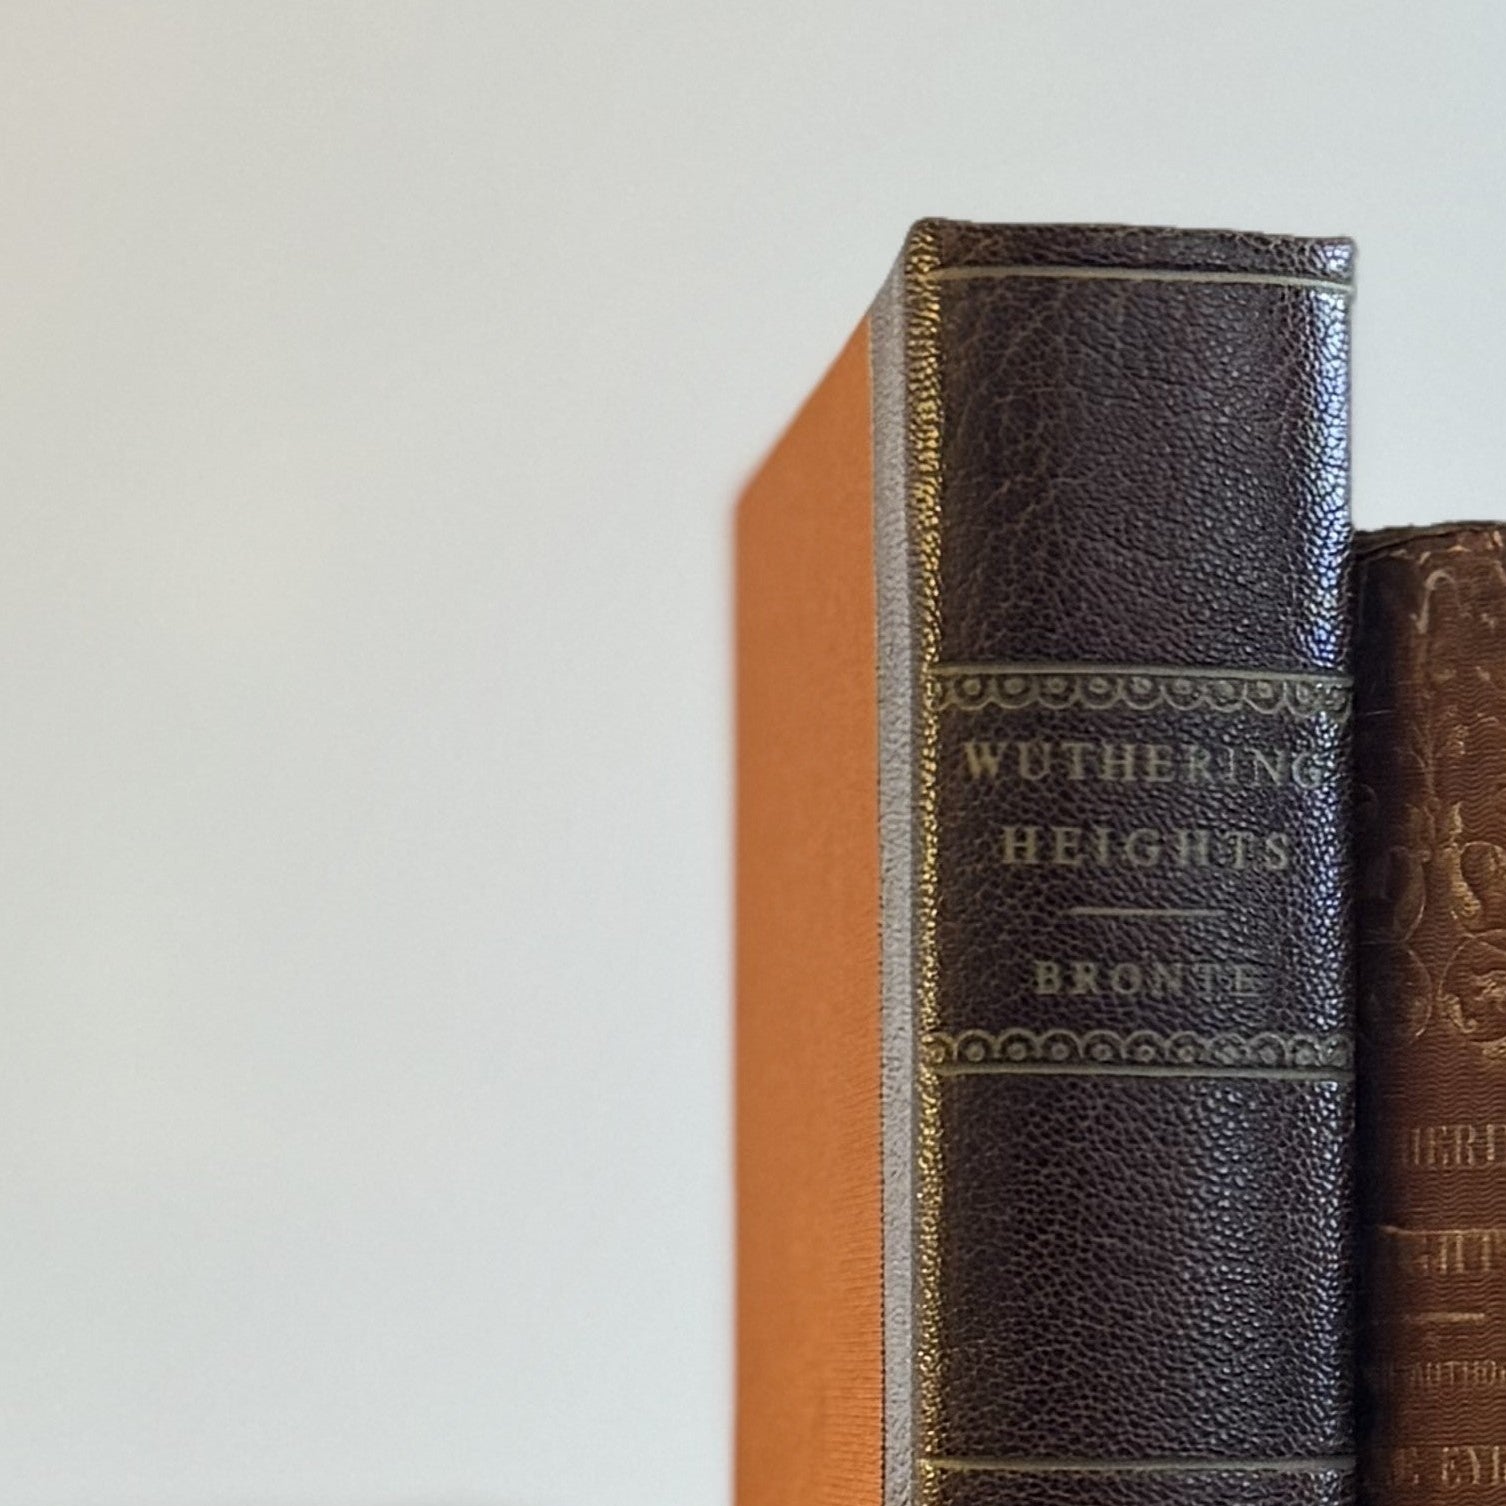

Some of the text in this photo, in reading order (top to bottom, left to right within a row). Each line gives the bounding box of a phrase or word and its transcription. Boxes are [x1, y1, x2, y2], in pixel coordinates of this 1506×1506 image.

[962, 740, 1328, 789] WUTHERING
[1000, 824, 1292, 871] HEIGHTS
[1032, 960, 1264, 998] BRONTE
